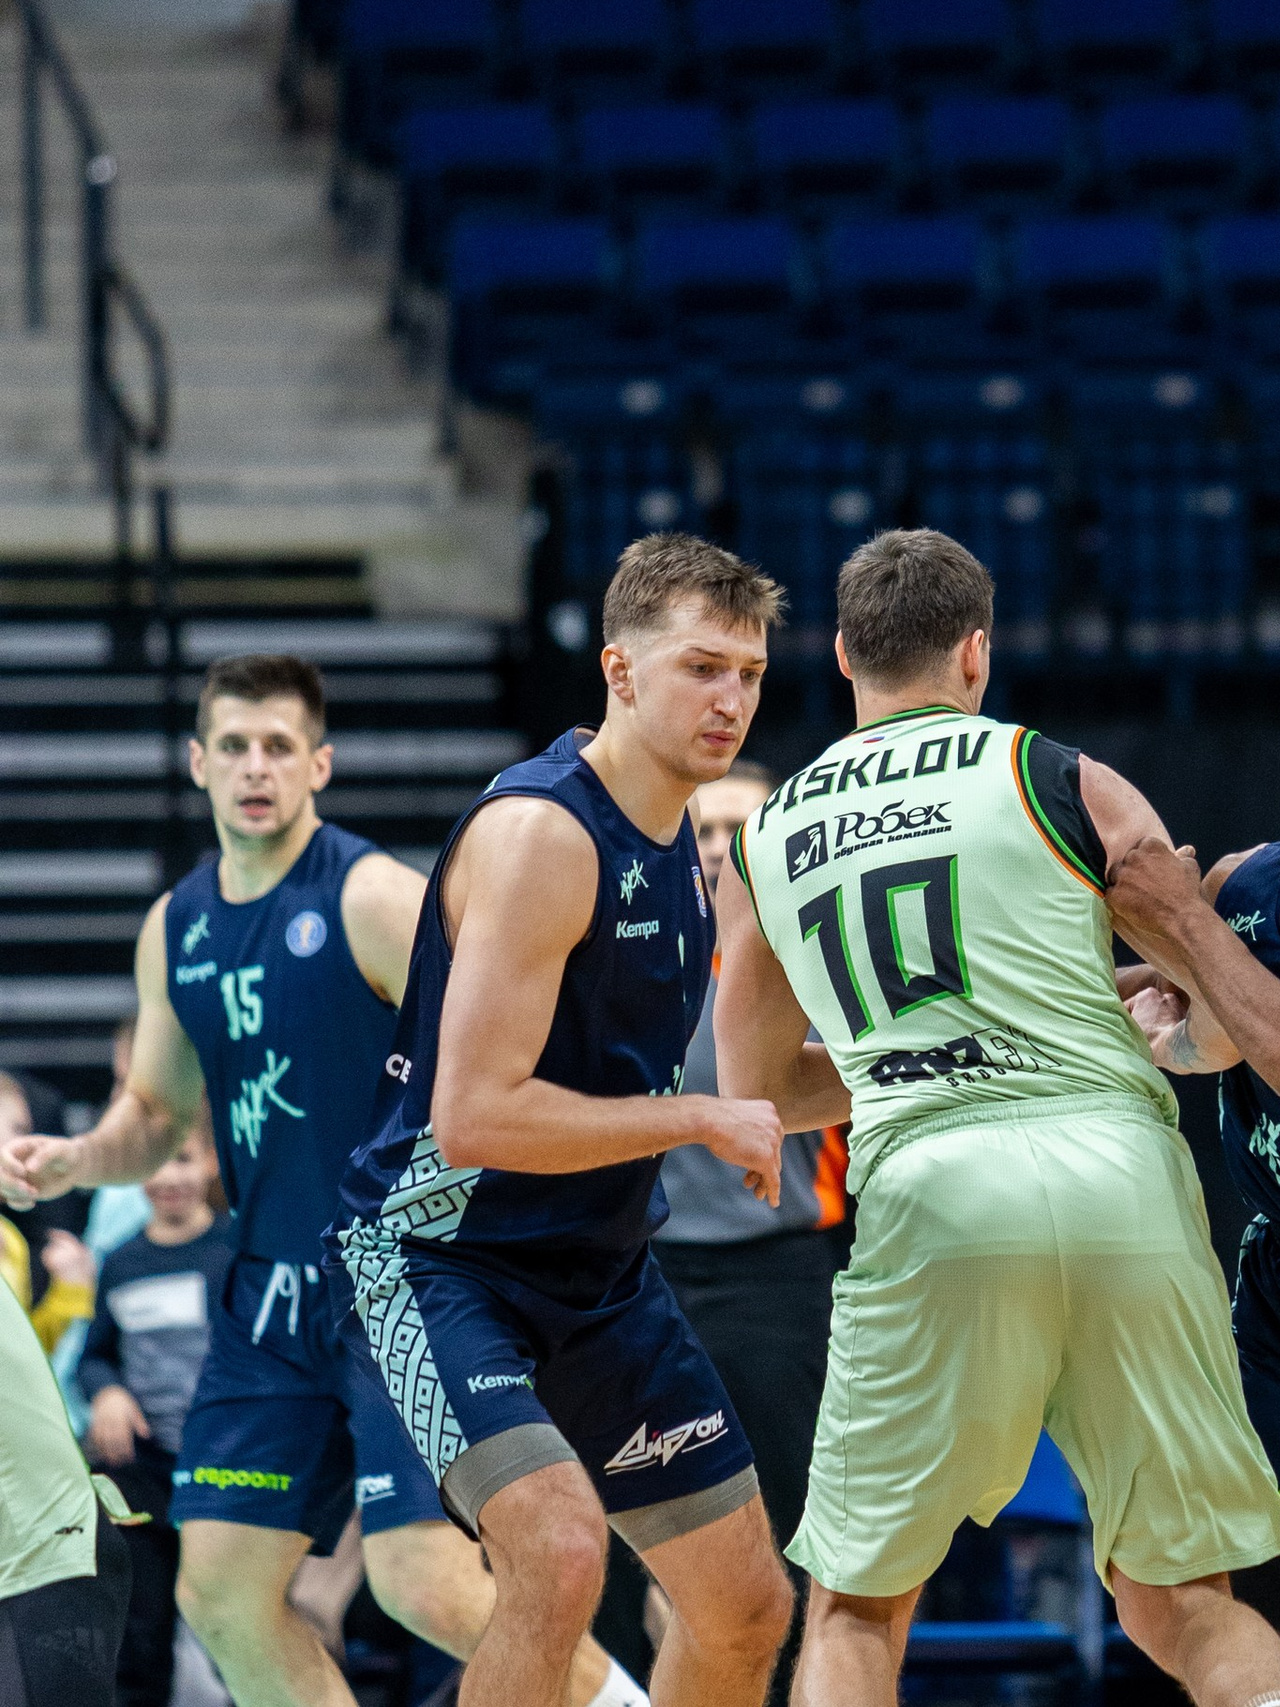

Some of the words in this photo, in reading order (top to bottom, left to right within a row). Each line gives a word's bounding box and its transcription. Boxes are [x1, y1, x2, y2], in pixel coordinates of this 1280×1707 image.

[758, 731, 992, 834] PISKLOV
[834, 799, 952, 848] Робек
[834, 838, 884, 860] обувная
[887, 825, 952, 843] компания
[616, 920, 660, 940] Kempa
[798, 854, 974, 1043] 10
[220, 964, 265, 1041] 15
[946, 1068, 1007, 1088] GROU
[467, 1373, 528, 1394] Kem
